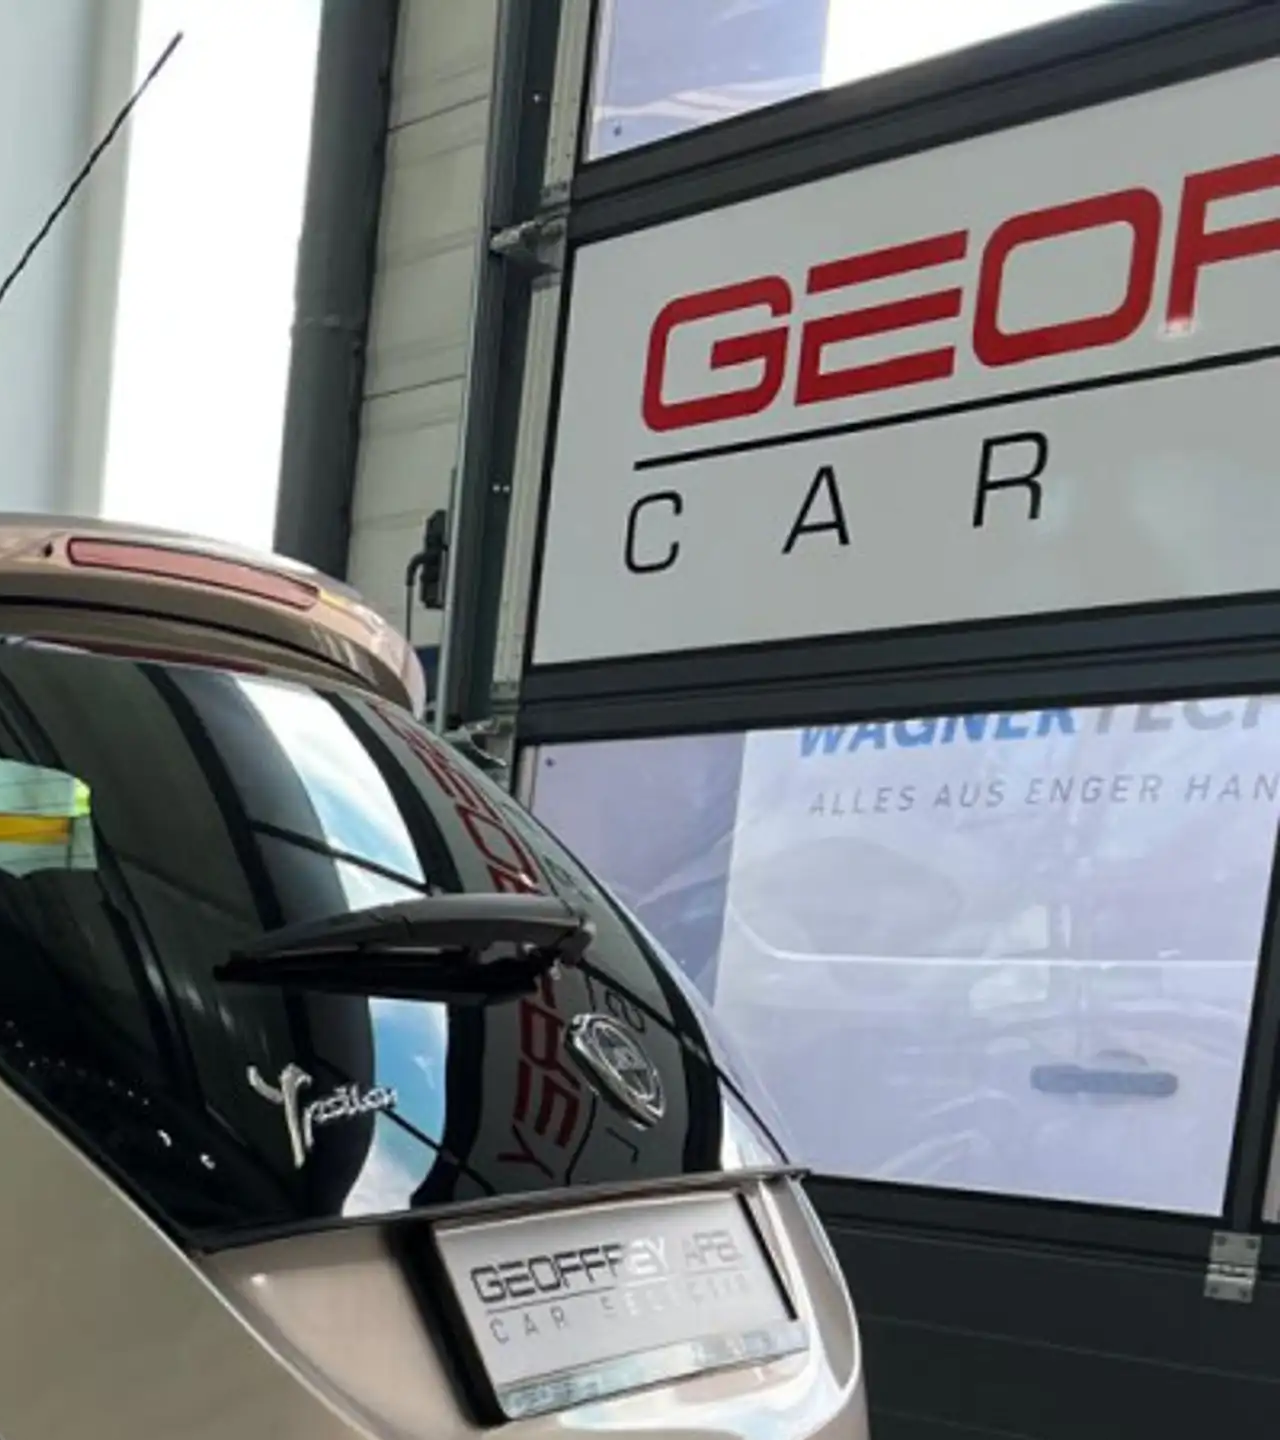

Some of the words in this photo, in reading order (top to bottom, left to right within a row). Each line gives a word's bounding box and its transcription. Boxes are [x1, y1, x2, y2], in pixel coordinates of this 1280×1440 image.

[807, 784, 917, 816] ALLES
[931, 779, 1006, 809] AUS
[1024, 772, 1164, 806] ENGER
